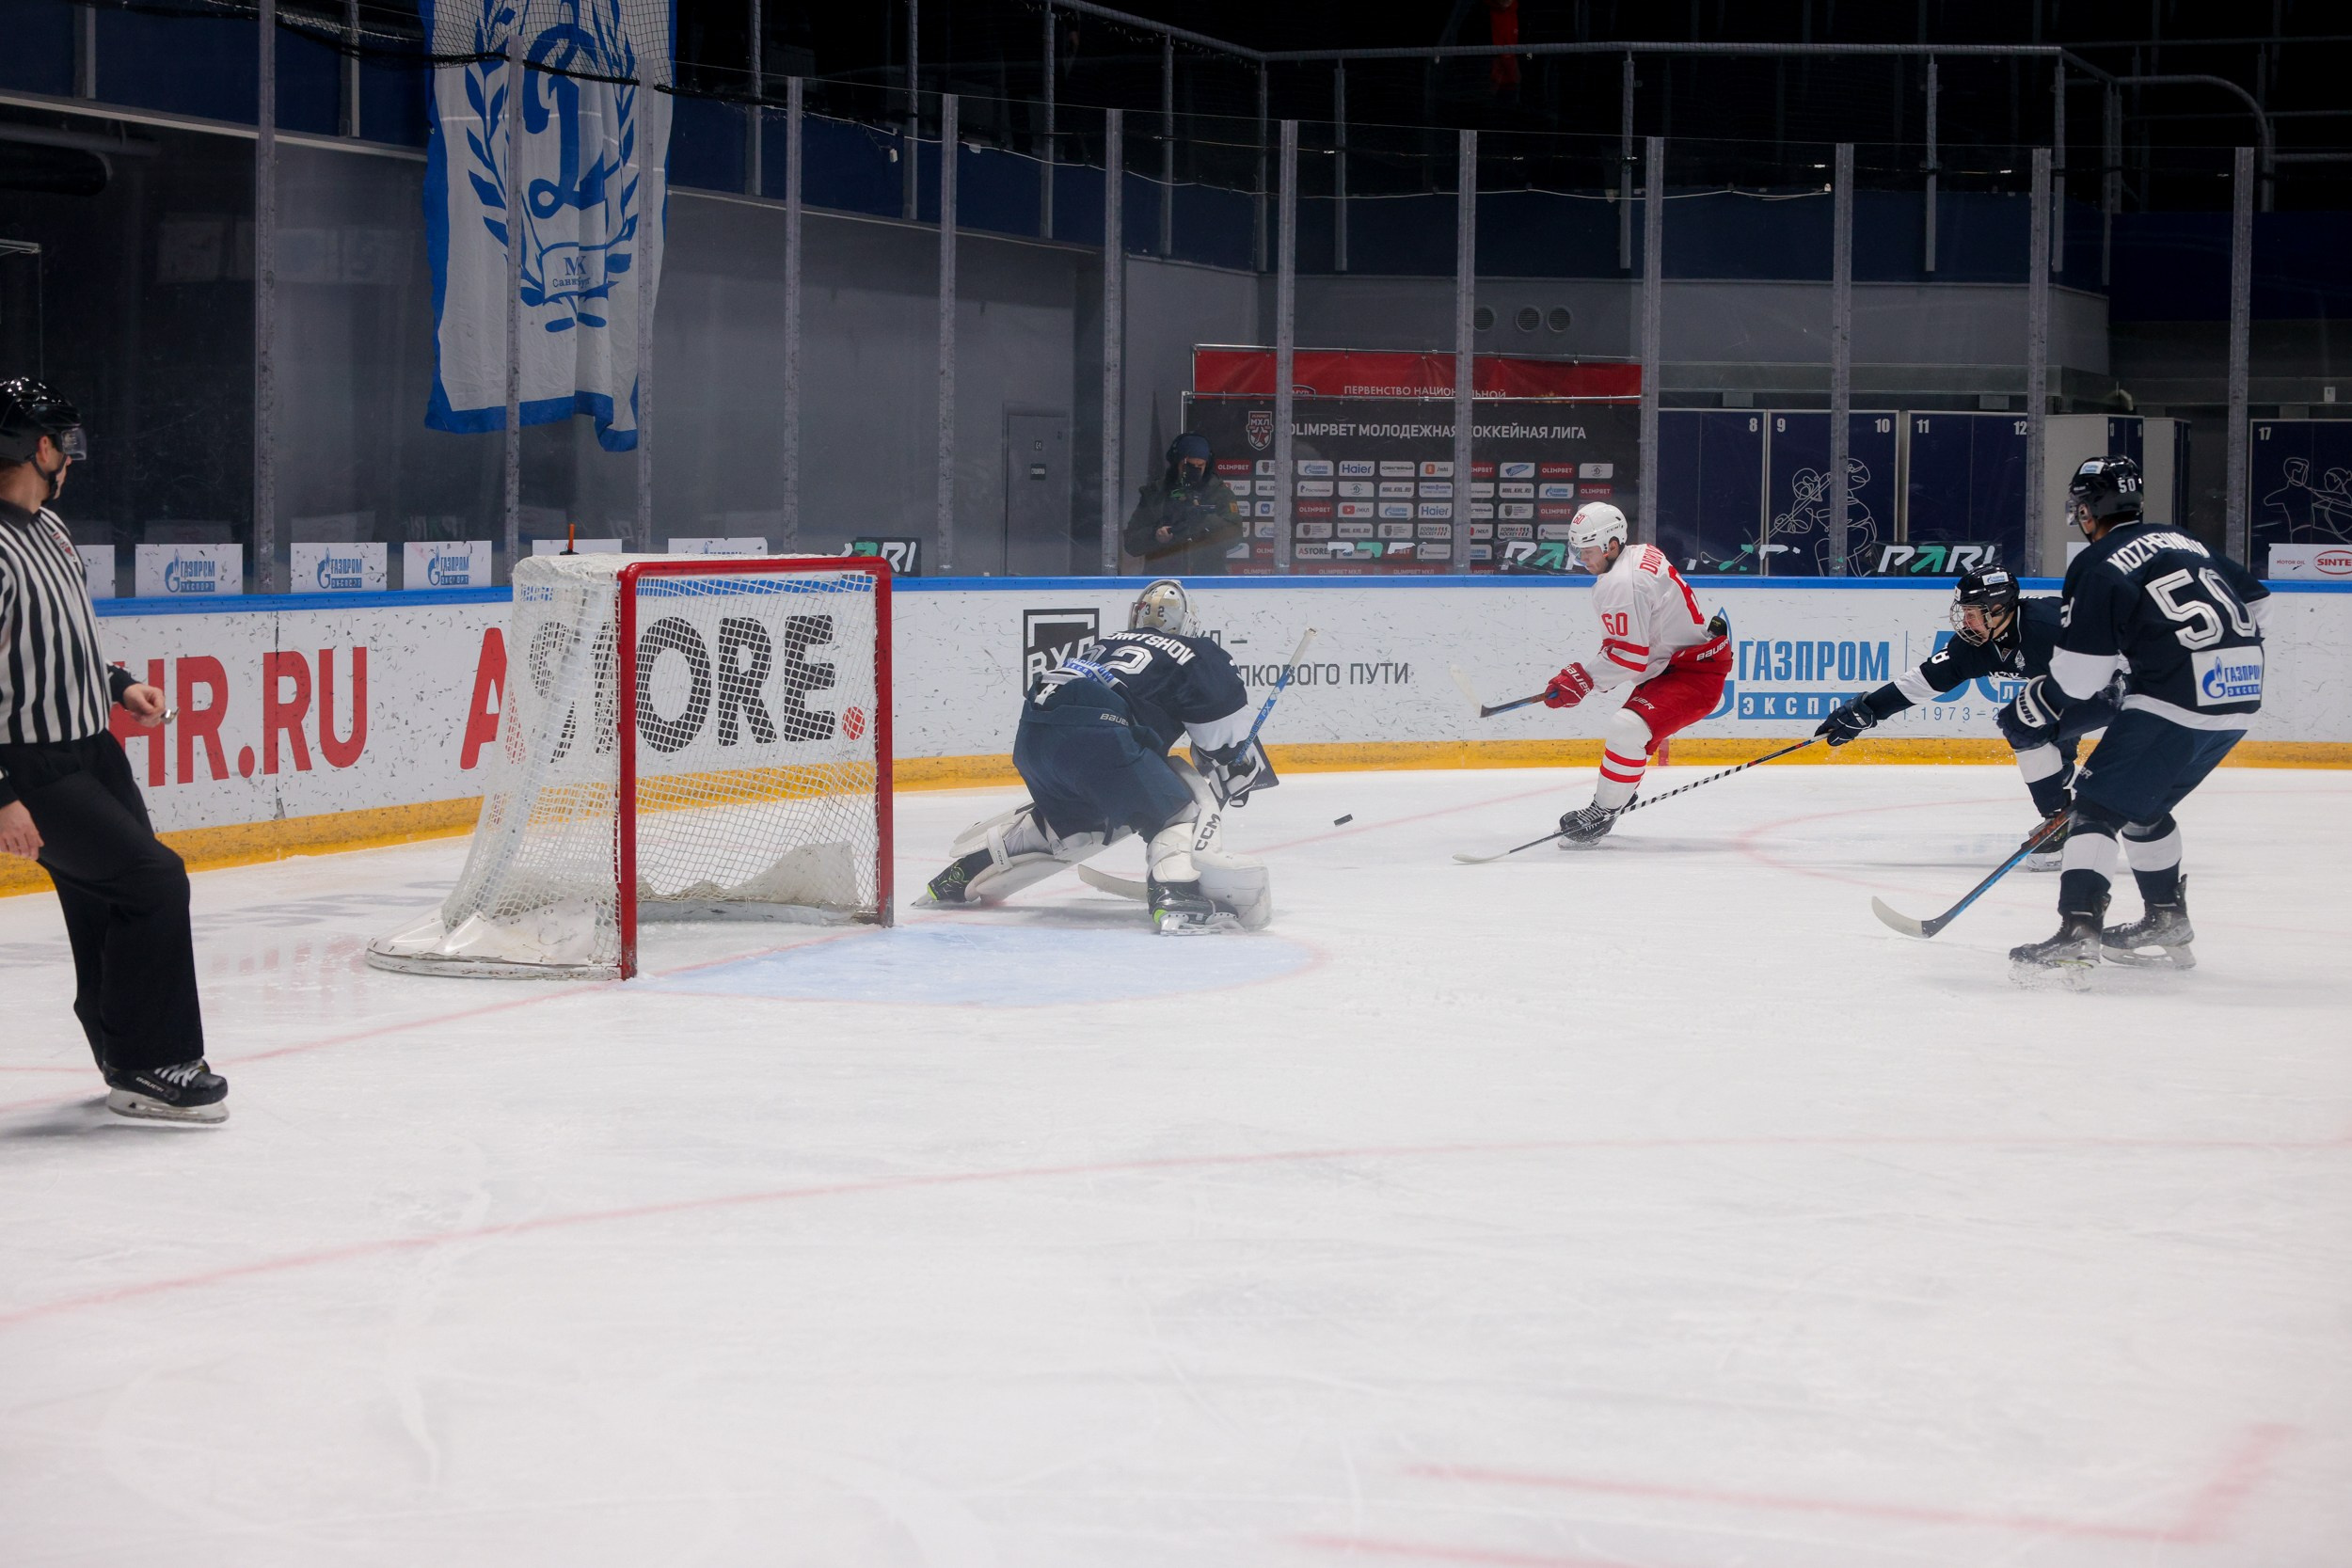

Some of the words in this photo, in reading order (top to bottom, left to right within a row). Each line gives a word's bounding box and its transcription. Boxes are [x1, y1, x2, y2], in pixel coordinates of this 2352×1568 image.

[1344, 386, 1411, 396] ПЕРВЕНСТВО
[1414, 386, 1506, 399] НАЦИОНЬНОЙ
[1471, 422, 1550, 439] ОККЕЙНАЯ
[1551, 426, 1587, 439] ЛИГА
[1749, 418, 1758, 433] 8
[1776, 418, 1787, 433] 9
[1875, 419, 1891, 434] 10
[1916, 420, 1931, 434] 11
[2014, 420, 2027, 436] 12
[2259, 427, 2272, 441] 17
[1342, 464, 1372, 474] Haier
[2118, 477, 2137, 494] 50
[1421, 505, 1449, 515] Haier
[1572, 514, 1586, 525] 60
[181, 561, 215, 577] ГАЗПРОМ
[331, 558, 362, 574] ГАЗПРОМ
[440, 556, 469, 572] ГАЗПРОМ
[1144, 603, 1166, 618] 32
[2144, 565, 2257, 651] 50
[1601, 612, 1629, 637] 60
[1696, 638, 1730, 661] BAUER
[1738, 641, 1890, 681] ГАЗПРОМ
[1348, 661, 1410, 686] ПУТИ
[2224, 664, 2262, 683] ГАЗПРО
[1741, 696, 1840, 716] ЭКСПО
[1194, 813, 1221, 851] CCM
[996, 849, 1006, 865] CCM
